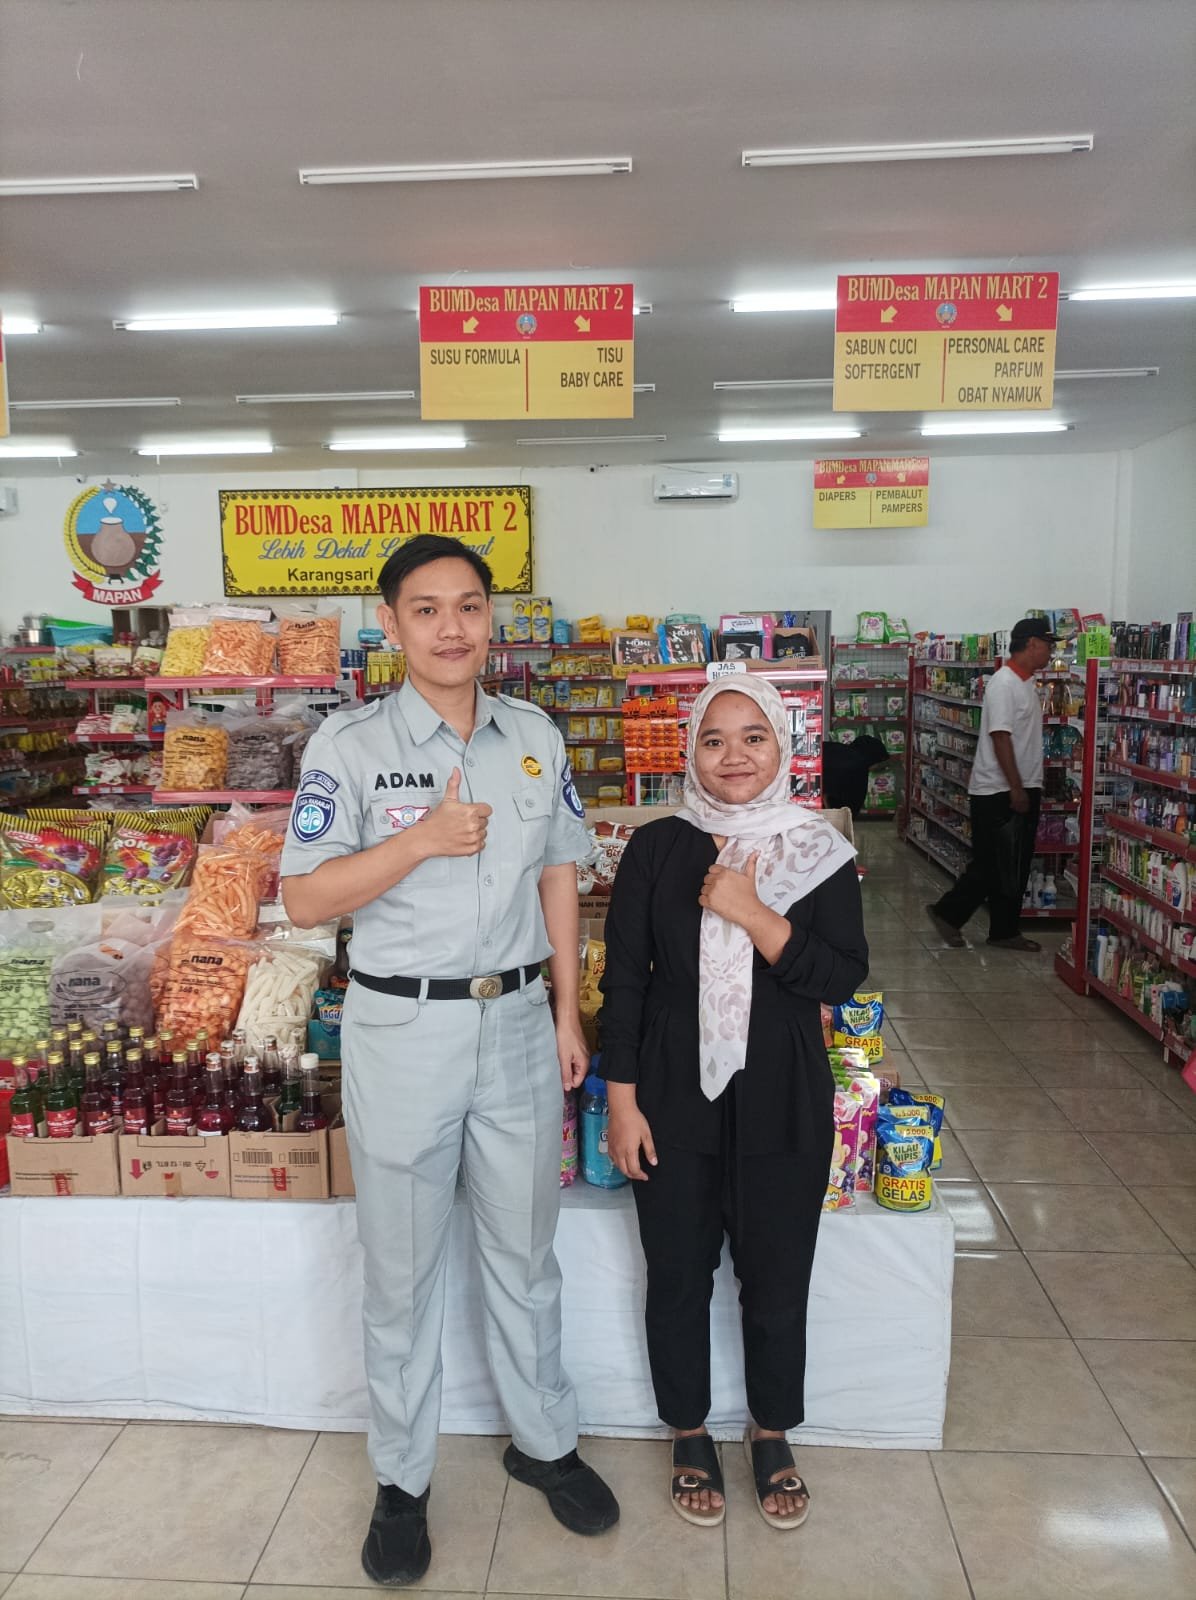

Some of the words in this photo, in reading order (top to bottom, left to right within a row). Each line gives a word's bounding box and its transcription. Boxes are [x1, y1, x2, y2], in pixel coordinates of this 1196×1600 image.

[848, 277, 919, 301] BUMDesa
[924, 276, 981, 300] MAPAN
[986, 275, 1034, 300] MART
[1038, 276, 1048, 299] 2
[430, 288, 500, 313] BUMDesa
[504, 287, 559, 311] MAPAN
[564, 286, 609, 311] MART
[614, 287, 624, 310] 2
[845, 339, 886, 355] SABUN
[889, 338, 917, 355] CUCI
[948, 337, 1010, 354] PERSONAL
[1013, 337, 1045, 353] CARE
[430, 349, 461, 365] SUSU
[465, 349, 521, 365] FORMULA
[597, 347, 623, 363] TISU
[844, 363, 921, 379] SOFTERGENT
[994, 362, 1043, 378] PARFUM
[561, 372, 590, 388] BABY
[593, 371, 624, 387] CARE
[958, 387, 988, 403] OBAT
[992, 386, 1042, 402] NYAMUK
[818, 491, 856, 502] DIAPERS
[876, 489, 923, 500] PEMBALUT
[881, 503, 923, 513] PAMPERS
[235, 504, 332, 535] BUMDesa
[342, 503, 421, 534] MAPAN
[429, 501, 494, 533] MART
[504, 501, 518, 532] 2
[258, 538, 305, 560] Lebih
[314, 537, 371, 560] Dekat
[287, 567, 374, 585] Karangsari
[92, 589, 142, 604] MAPAN
[717, 663, 736, 671] JAS
[374, 773, 435, 790] ADAM
[191, 955, 223, 966] nana
[68, 977, 100, 987] nana
[845, 1036, 880, 1048] GRATIS
[893, 1144, 918, 1155] KILAU
[895, 1152, 919, 1161] NIPIS
[882, 1176, 926, 1190] GRATIS
[882, 1187, 925, 1202] GELAS
